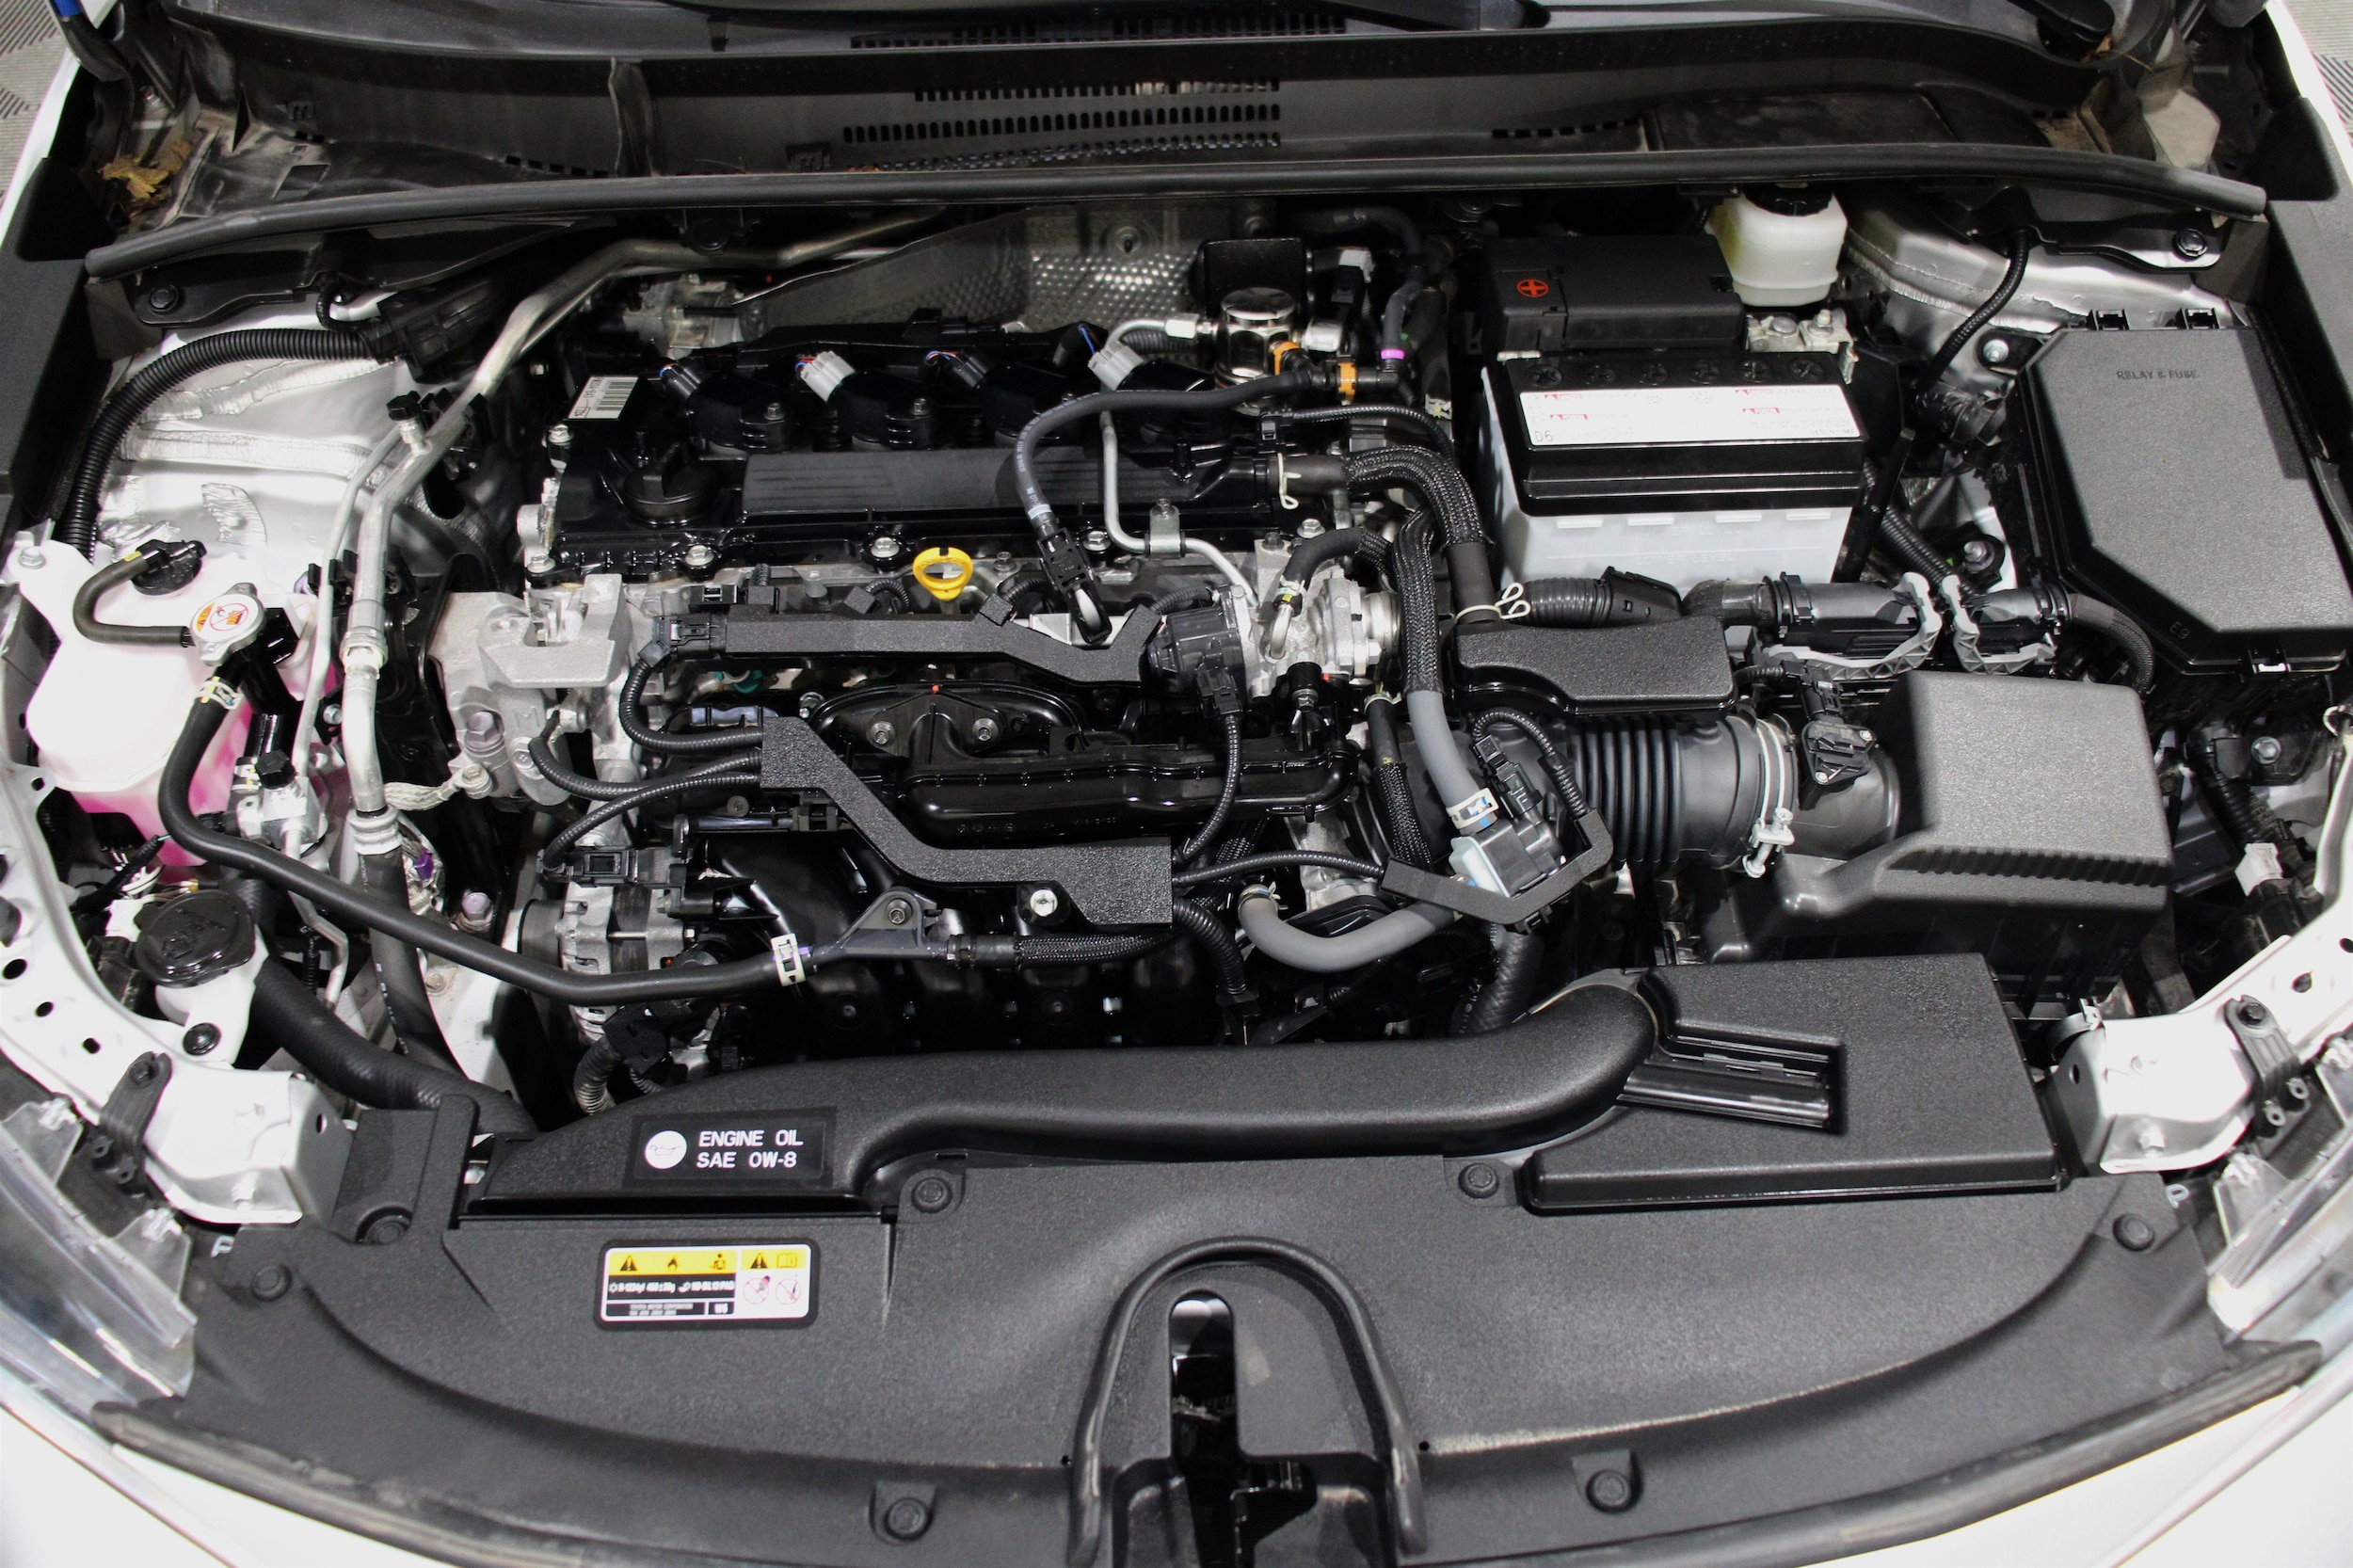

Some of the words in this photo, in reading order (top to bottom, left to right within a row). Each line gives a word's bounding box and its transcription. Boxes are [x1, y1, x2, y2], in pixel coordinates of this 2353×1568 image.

[2117, 370, 2153, 380] RELAY
[2168, 369, 2198, 379] FUSE
[1534, 430, 1554, 442] D6
[699, 1130, 764, 1147] ENGINE
[776, 1129, 804, 1146] OIL
[696, 1151, 737, 1169] SAE
[748, 1150, 798, 1169] 0W-8
